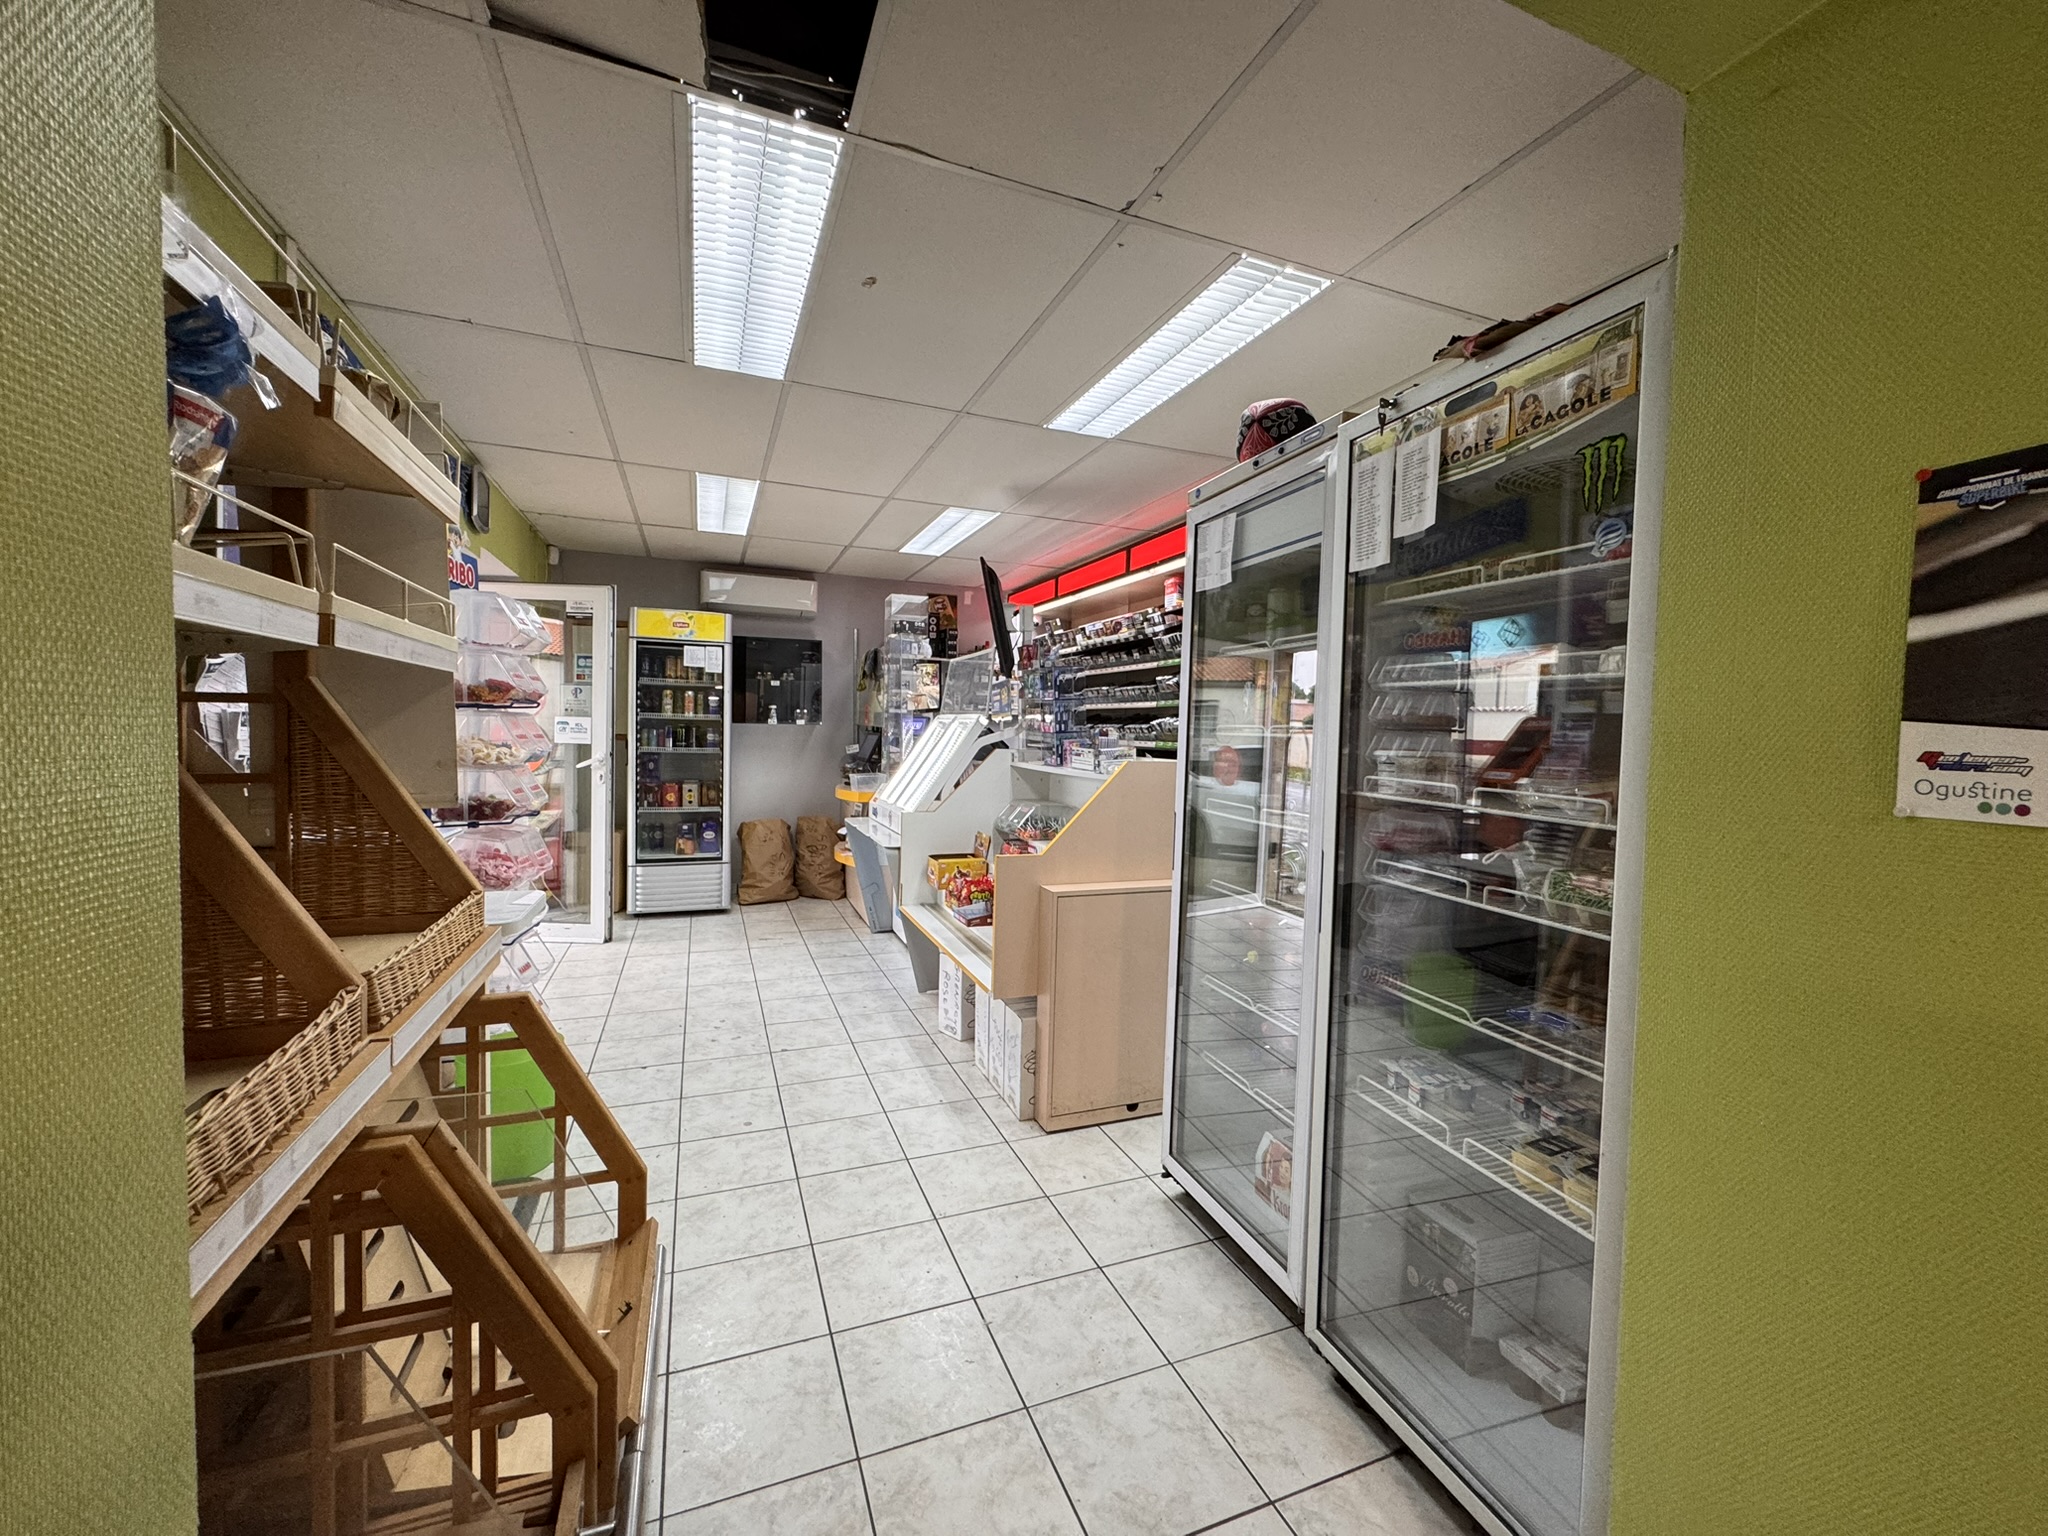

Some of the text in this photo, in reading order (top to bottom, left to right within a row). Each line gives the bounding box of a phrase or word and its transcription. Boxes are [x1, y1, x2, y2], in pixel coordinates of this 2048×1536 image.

[1530, 386, 1612, 430] CAGOLE
[1937, 479, 2002, 499] CHAMPIONNAT
[1959, 481, 2027, 505] SUPERBIKE
[929, 616, 937, 639] OCB
[1914, 779, 2033, 801] Ogustine
